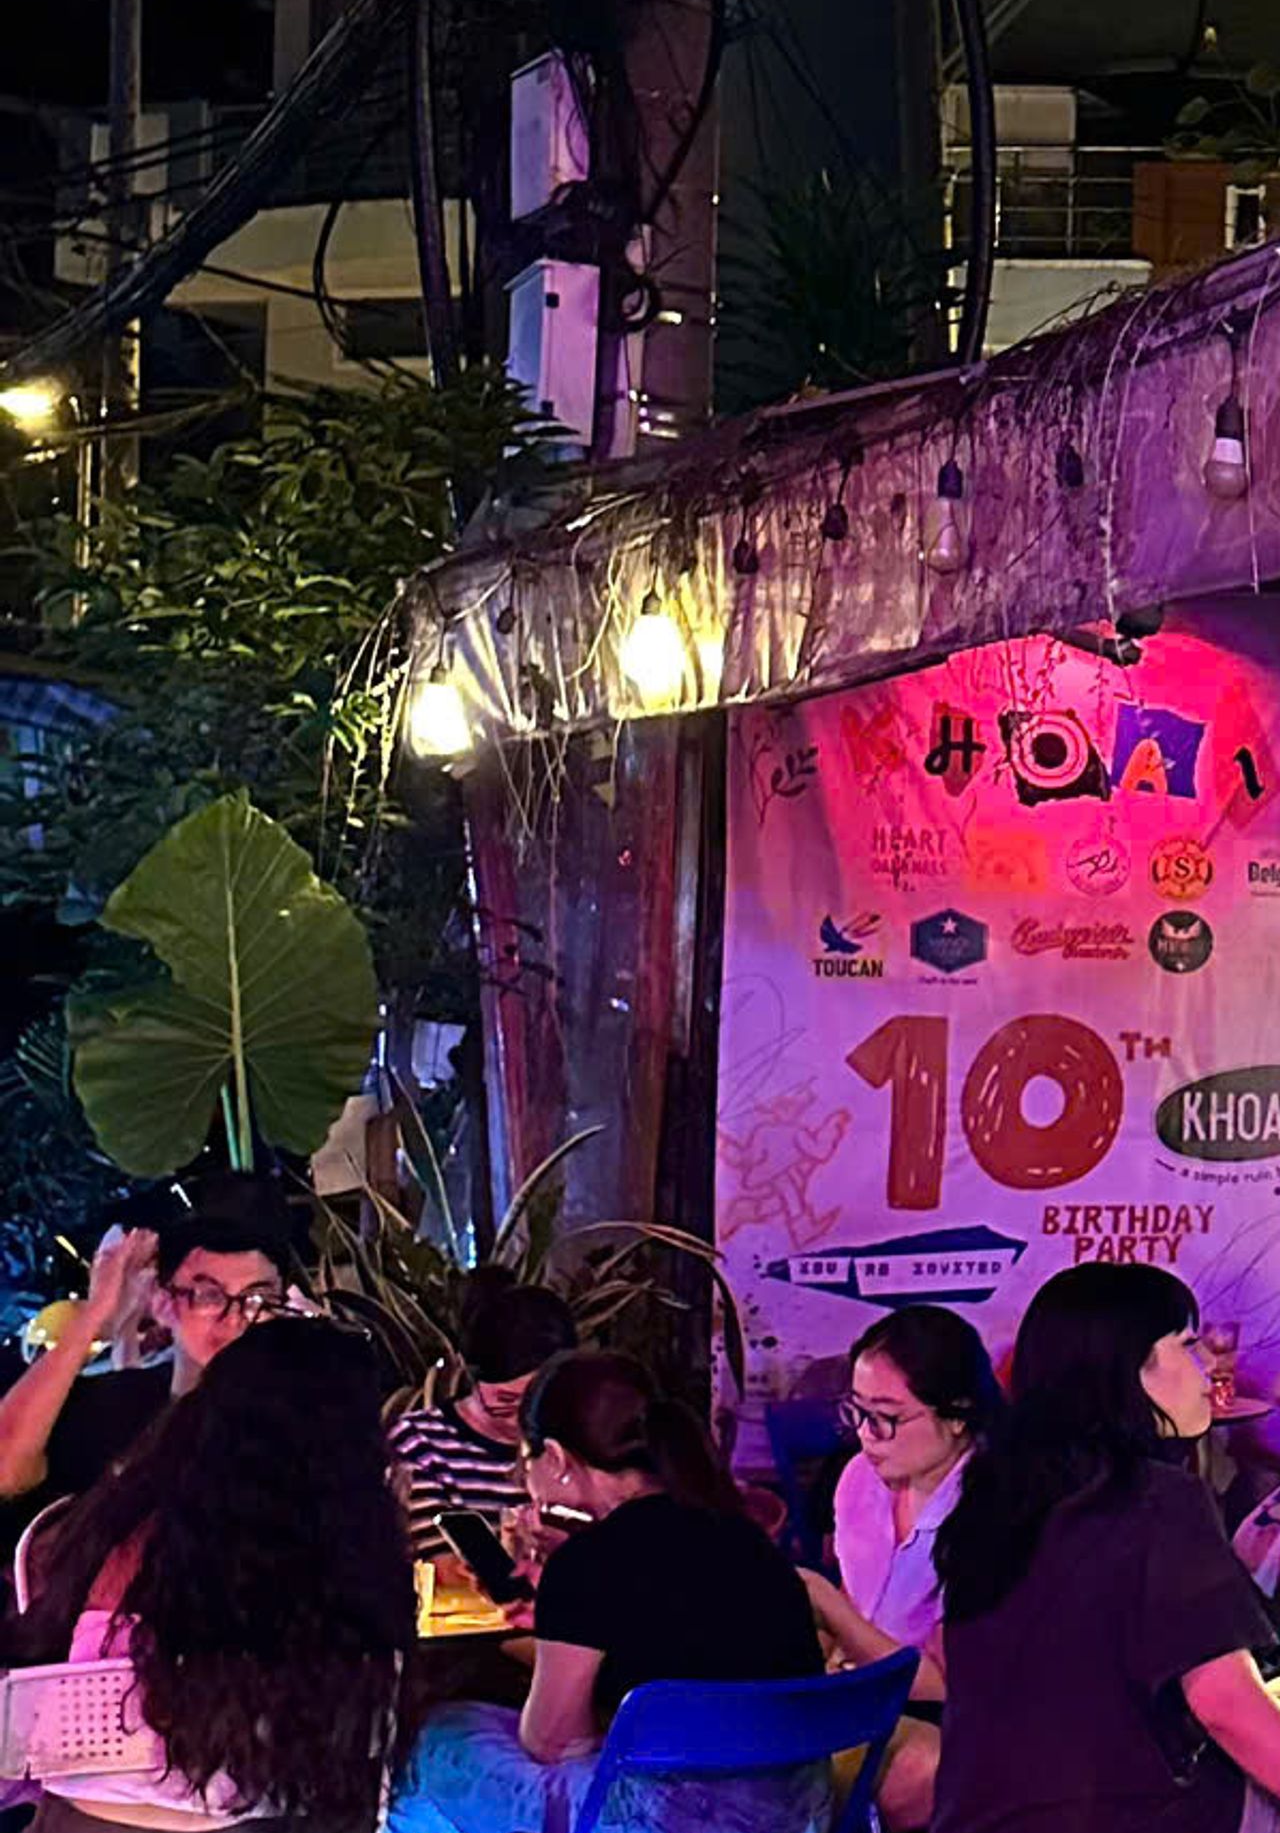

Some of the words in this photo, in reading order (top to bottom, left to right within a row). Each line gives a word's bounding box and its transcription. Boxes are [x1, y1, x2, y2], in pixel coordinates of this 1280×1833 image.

[812, 959, 884, 977] TOUCAN
[1042, 1204, 1215, 1235] BIRTHDAY
[1074, 1234, 1183, 1264] PARTY
